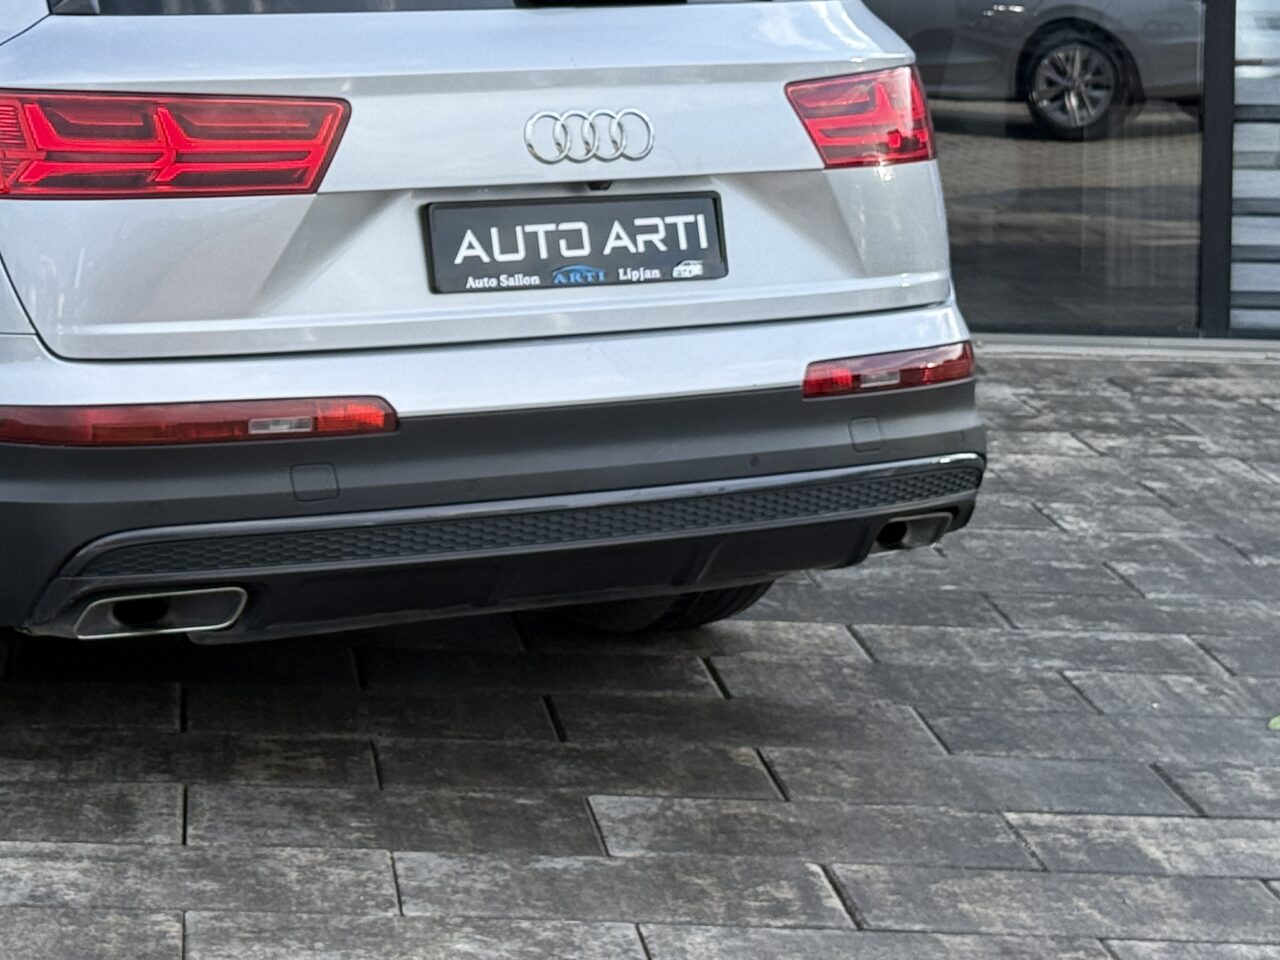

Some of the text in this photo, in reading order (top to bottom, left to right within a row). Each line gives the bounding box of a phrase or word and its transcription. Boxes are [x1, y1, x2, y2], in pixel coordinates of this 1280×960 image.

[454, 213, 709, 265] AUTO ARTI
[465, 275, 498, 289] Auto
[553, 270, 606, 285] ARTI
